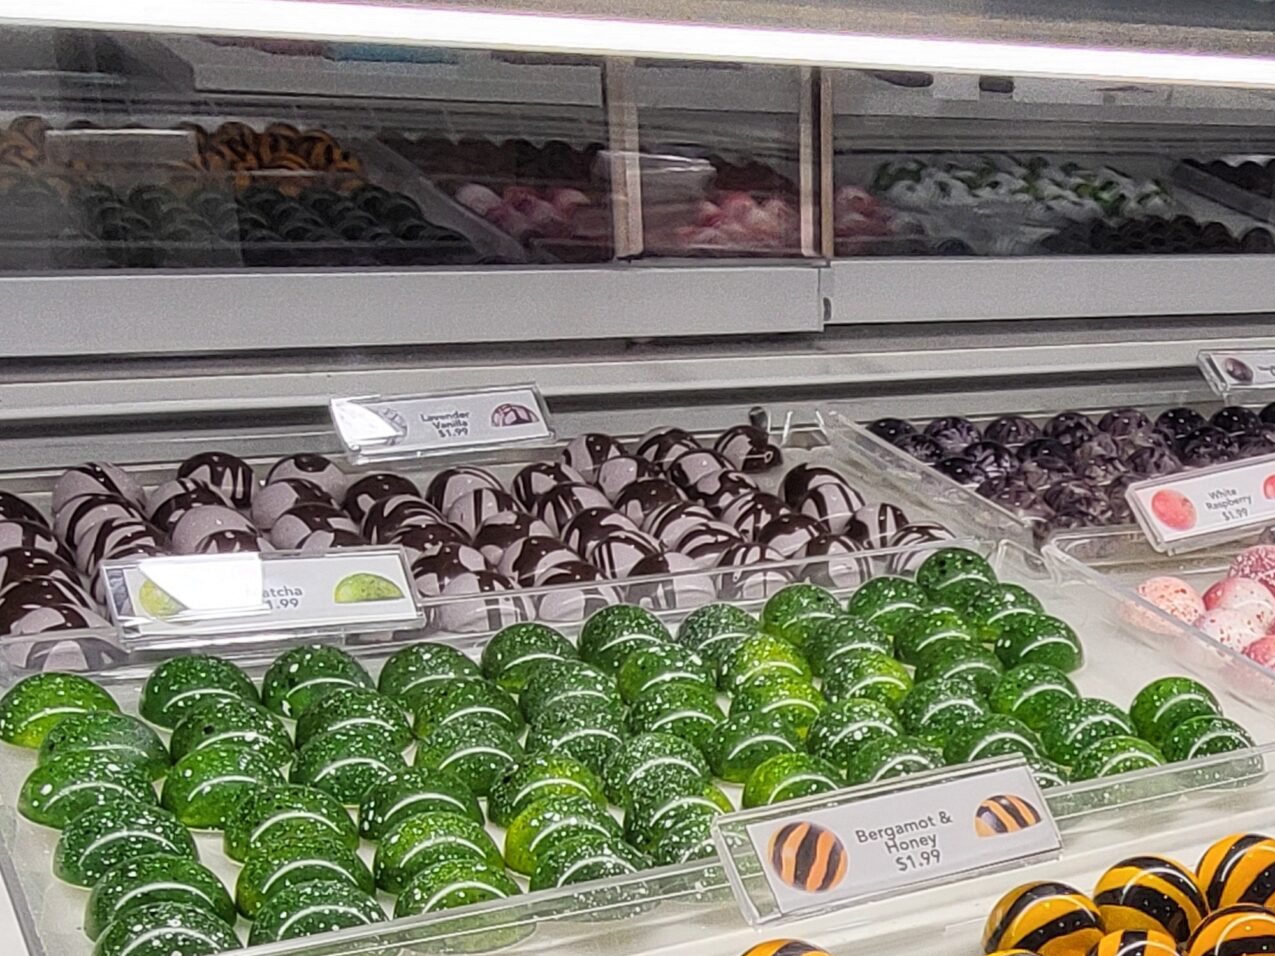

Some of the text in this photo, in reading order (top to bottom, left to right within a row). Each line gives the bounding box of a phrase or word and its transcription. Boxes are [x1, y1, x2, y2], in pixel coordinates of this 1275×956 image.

[420, 411, 470, 422] Lavender
[432, 421, 468, 430] Vanilla
[438, 428, 469, 438] $1.99
[1208, 489, 1237, 500] White
[1206, 495, 1252, 509] Raspberry
[1222, 508, 1248, 521] $1.99
[255, 585, 303, 598] atcha
[262, 599, 299, 609] 1.99
[855, 811, 953, 843] Bergamot &
[885, 836, 937, 856] Honey
[896, 850, 941, 872] $1.99
